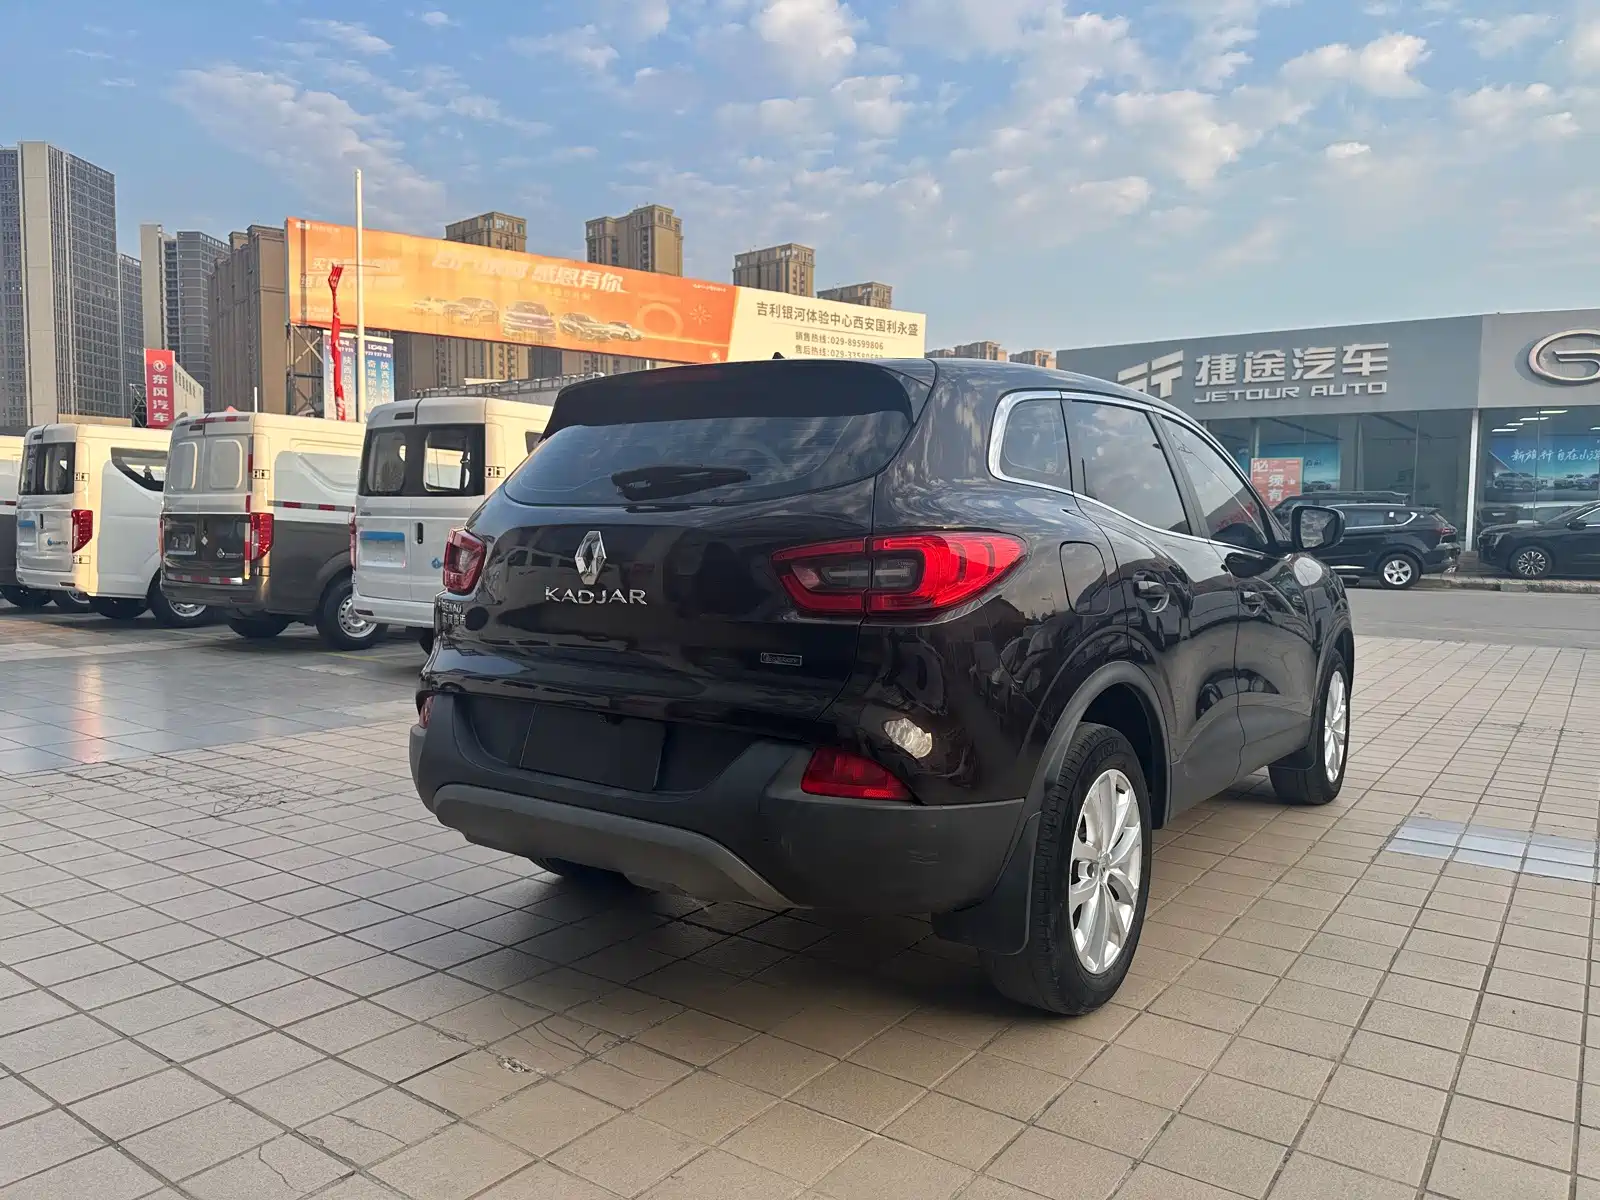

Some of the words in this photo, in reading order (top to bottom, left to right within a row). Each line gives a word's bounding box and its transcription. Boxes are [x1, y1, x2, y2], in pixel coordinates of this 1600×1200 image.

[756, 301, 918, 337] 吉利银河体验中心西安国利永盛
[1195, 343, 1389, 386] 捷途汽车
[152, 374, 169, 423] 东风汽车
[1194, 386, 1300, 403] JETOUR
[1310, 381, 1388, 397] AUTO
[545, 586, 647, 605] KADJAR
